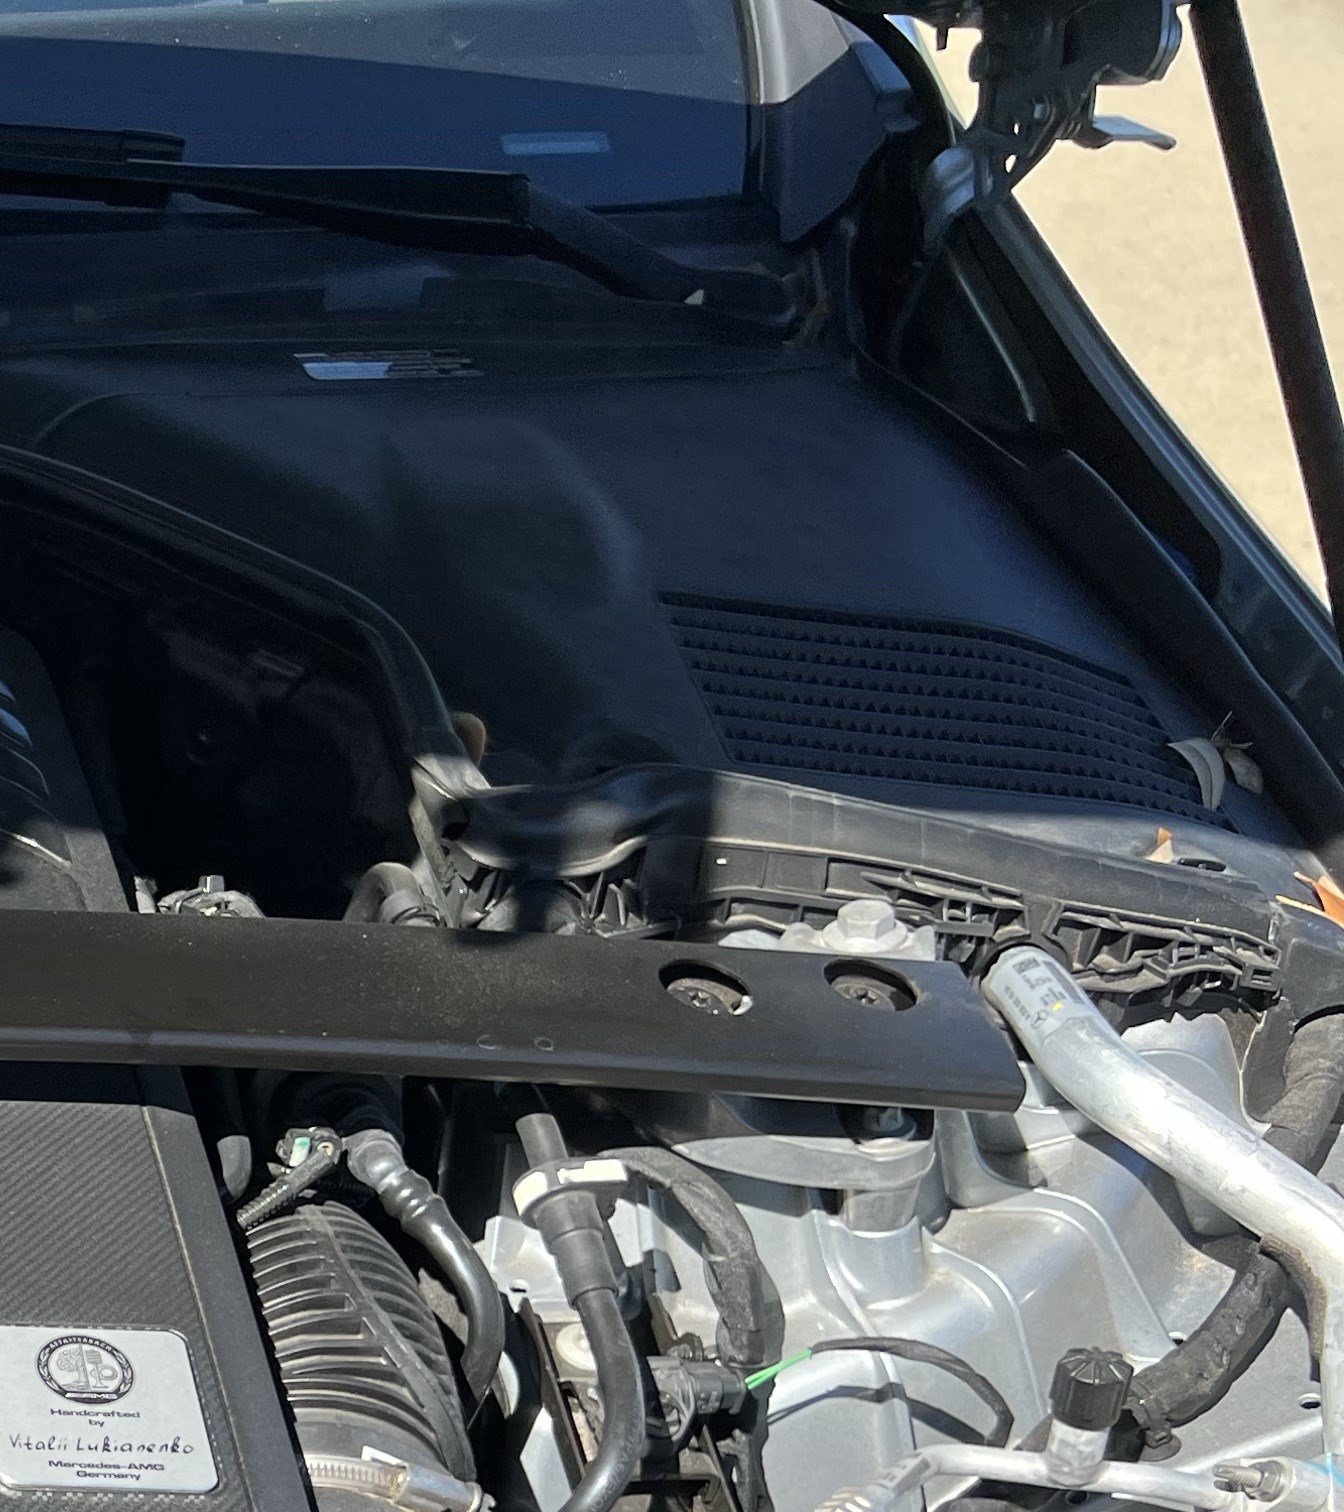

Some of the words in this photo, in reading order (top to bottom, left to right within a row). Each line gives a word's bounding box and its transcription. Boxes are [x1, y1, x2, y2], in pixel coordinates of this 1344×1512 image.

[50, 1407, 141, 1419] Handcrafted
[88, 1418, 105, 1428] by
[48, 1460, 166, 1471] Mercedes-AMG
[76, 1470, 142, 1482] Germany
